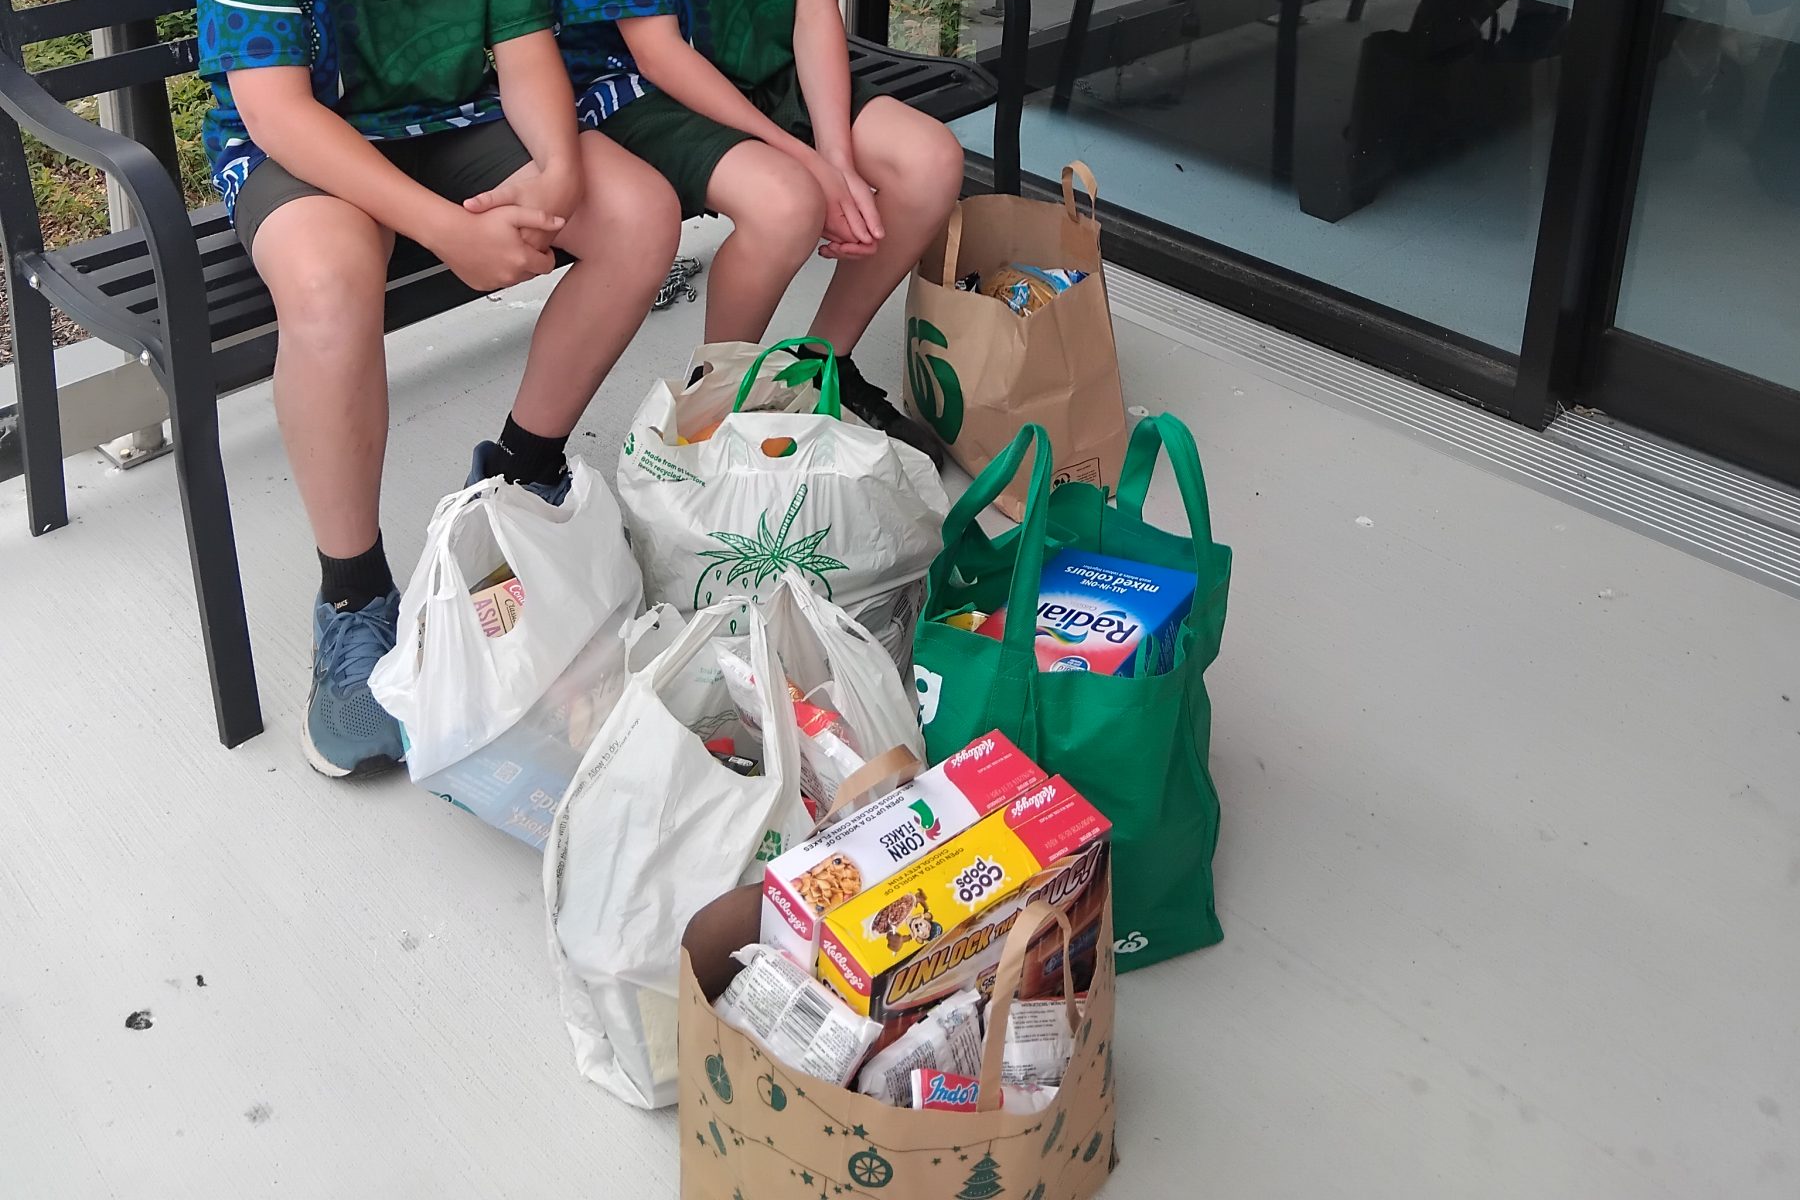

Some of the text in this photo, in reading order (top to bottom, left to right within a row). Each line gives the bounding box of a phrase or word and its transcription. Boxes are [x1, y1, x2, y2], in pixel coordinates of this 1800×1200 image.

[644, 449, 662, 463] Made
[662, 459, 677, 470] from
[1064, 566, 1160, 593] mixed colours
[1079, 578, 1128, 593] ALL-IN-ONE
[951, 738, 995, 768] Kellogg's
[1011, 784, 1057, 818] Kellogg's
[880, 821, 915, 848] FLAKES
[887, 832, 925, 862] CORN
[956, 858, 988, 889] pops
[959, 864, 1003, 902] COCO
[767, 884, 808, 936] Kellogg's
[823, 939, 865, 991] Kellogg's
[886, 922, 995, 1005] UNLOCK
